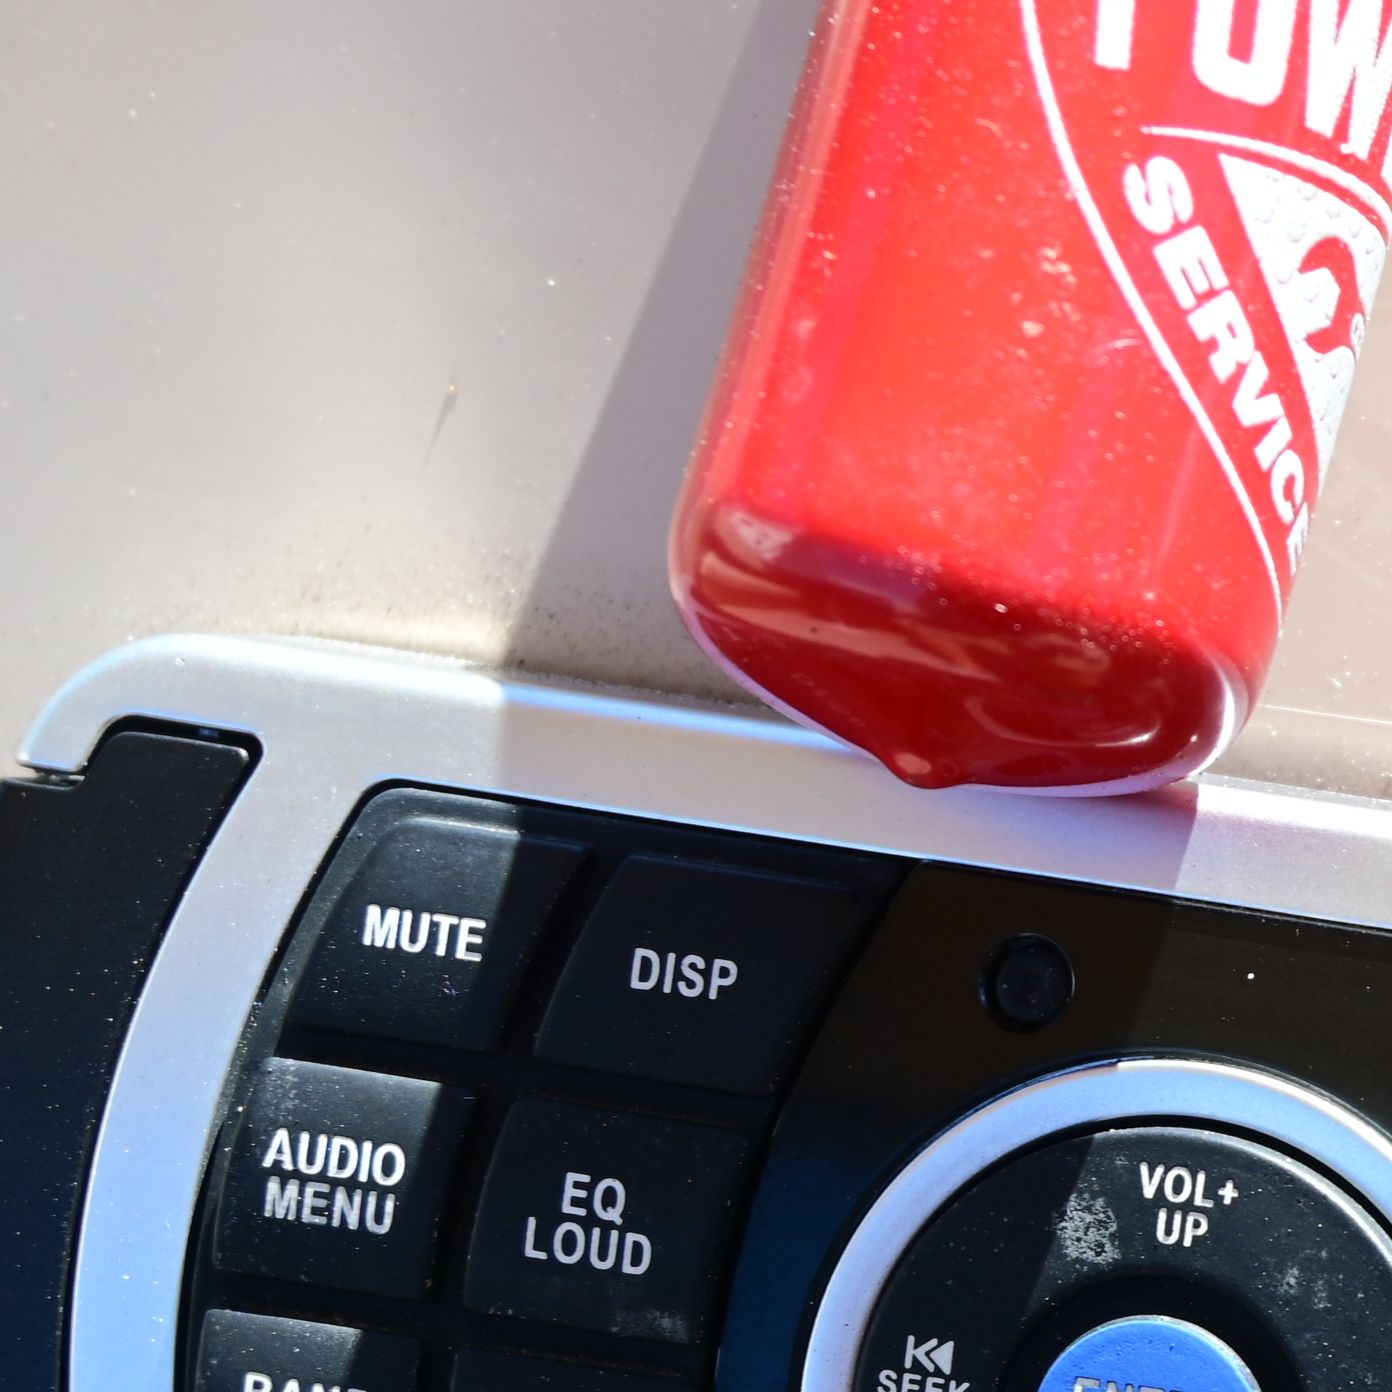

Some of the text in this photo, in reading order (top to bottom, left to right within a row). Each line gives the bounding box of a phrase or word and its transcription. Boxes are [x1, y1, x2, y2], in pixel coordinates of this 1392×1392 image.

[363, 905, 486, 961] MUTE
[631, 948, 737, 999] DISP
[261, 1127, 406, 1187] AUDIO
[1140, 1162, 1238, 1207] VOL+
[263, 1176, 396, 1235] MENU
[560, 1171, 627, 1226] EQ
[524, 1216, 652, 1276] LOUD
[1157, 1208, 1208, 1247] UP
